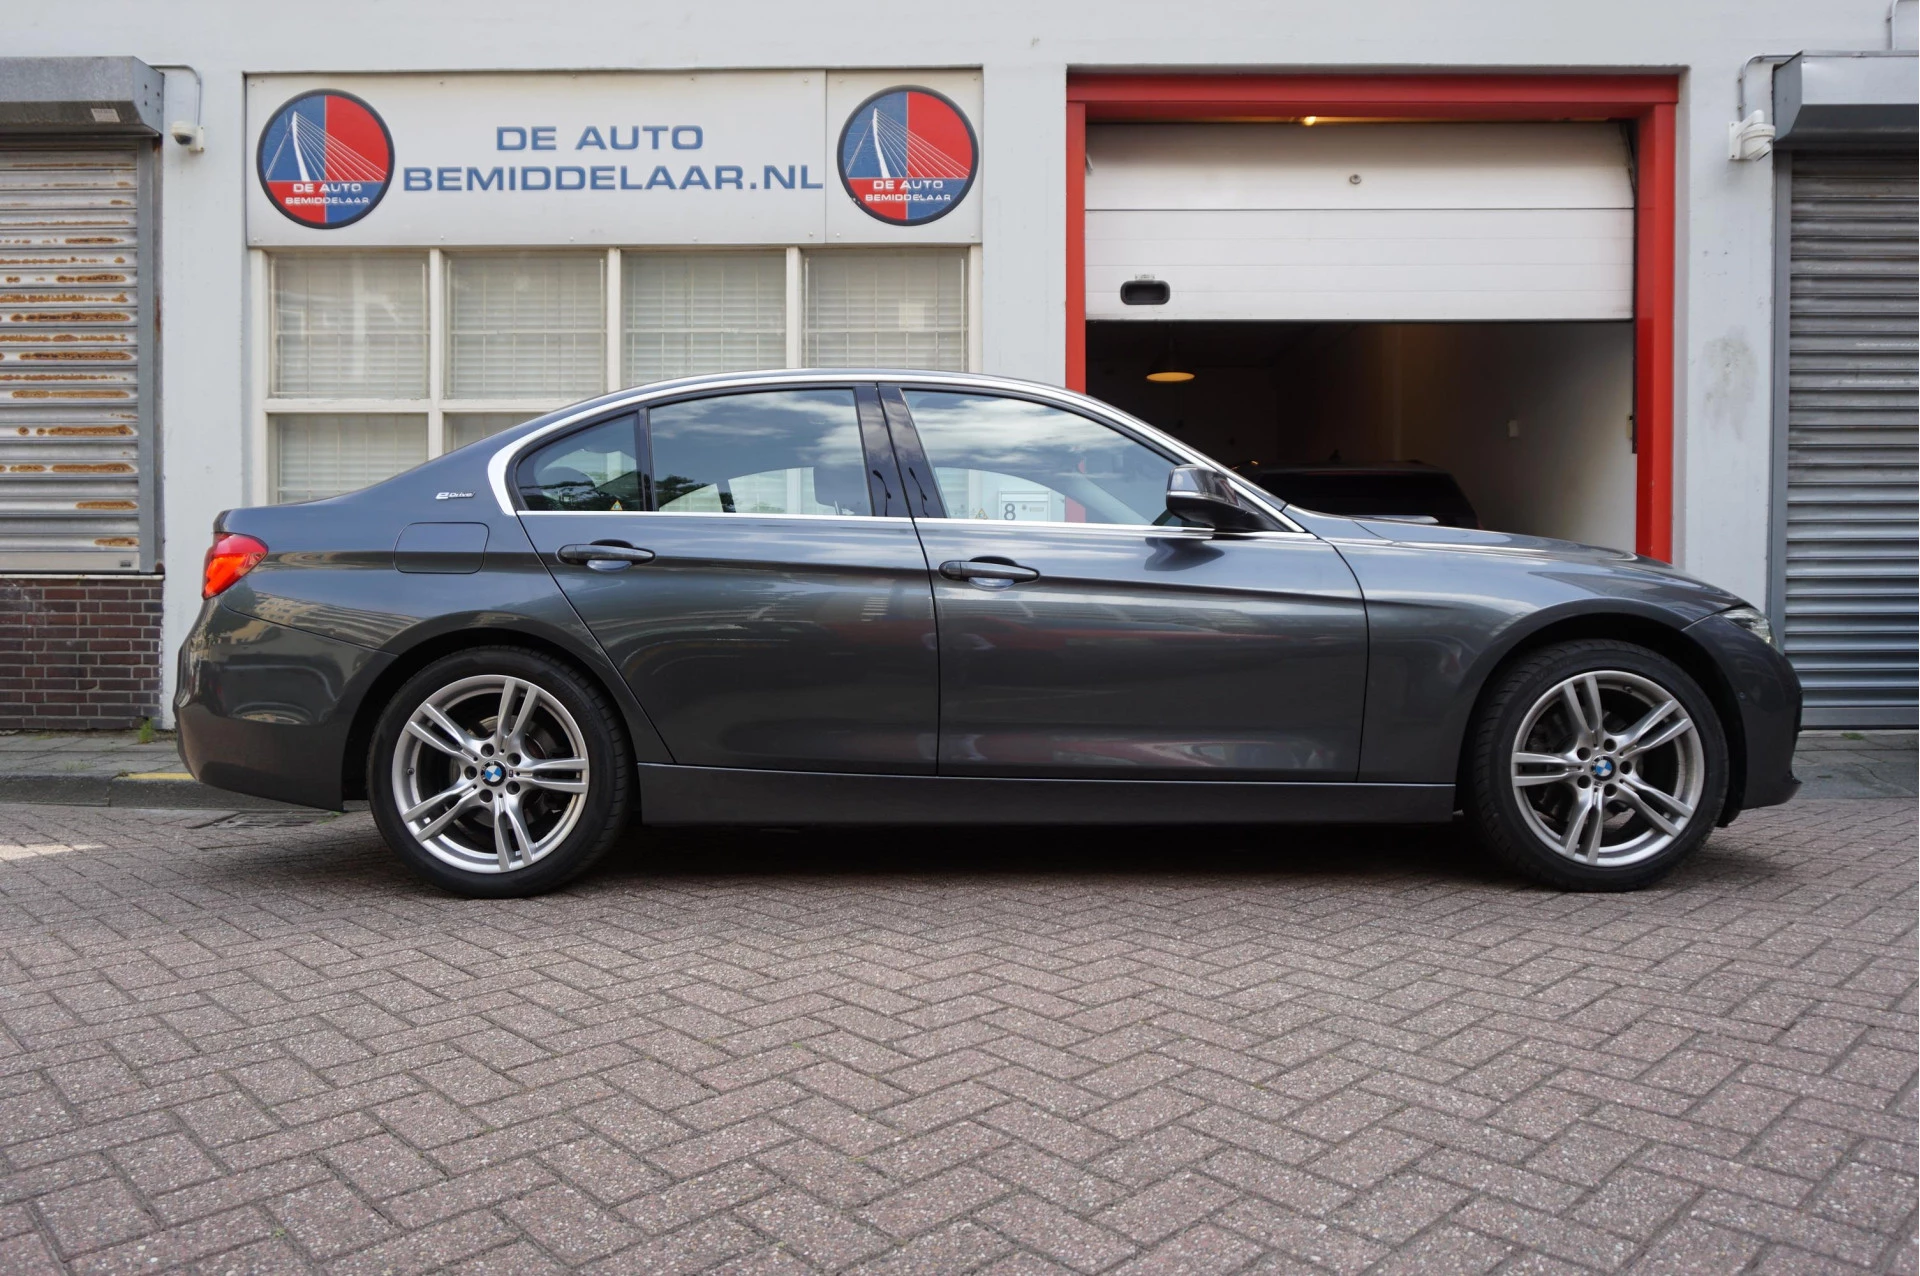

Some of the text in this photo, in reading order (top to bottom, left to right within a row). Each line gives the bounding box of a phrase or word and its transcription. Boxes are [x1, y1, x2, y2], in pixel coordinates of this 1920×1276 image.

[495, 124, 704, 152] DE AUTO
[403, 164, 824, 192] BEMIDDELAAR.NL
[292, 182, 362, 194] DE AUTO
[872, 179, 944, 191] DE AUTO
[285, 195, 369, 206] BEMIDDELAAR
[864, 192, 951, 203] BEMIDDELAAR
